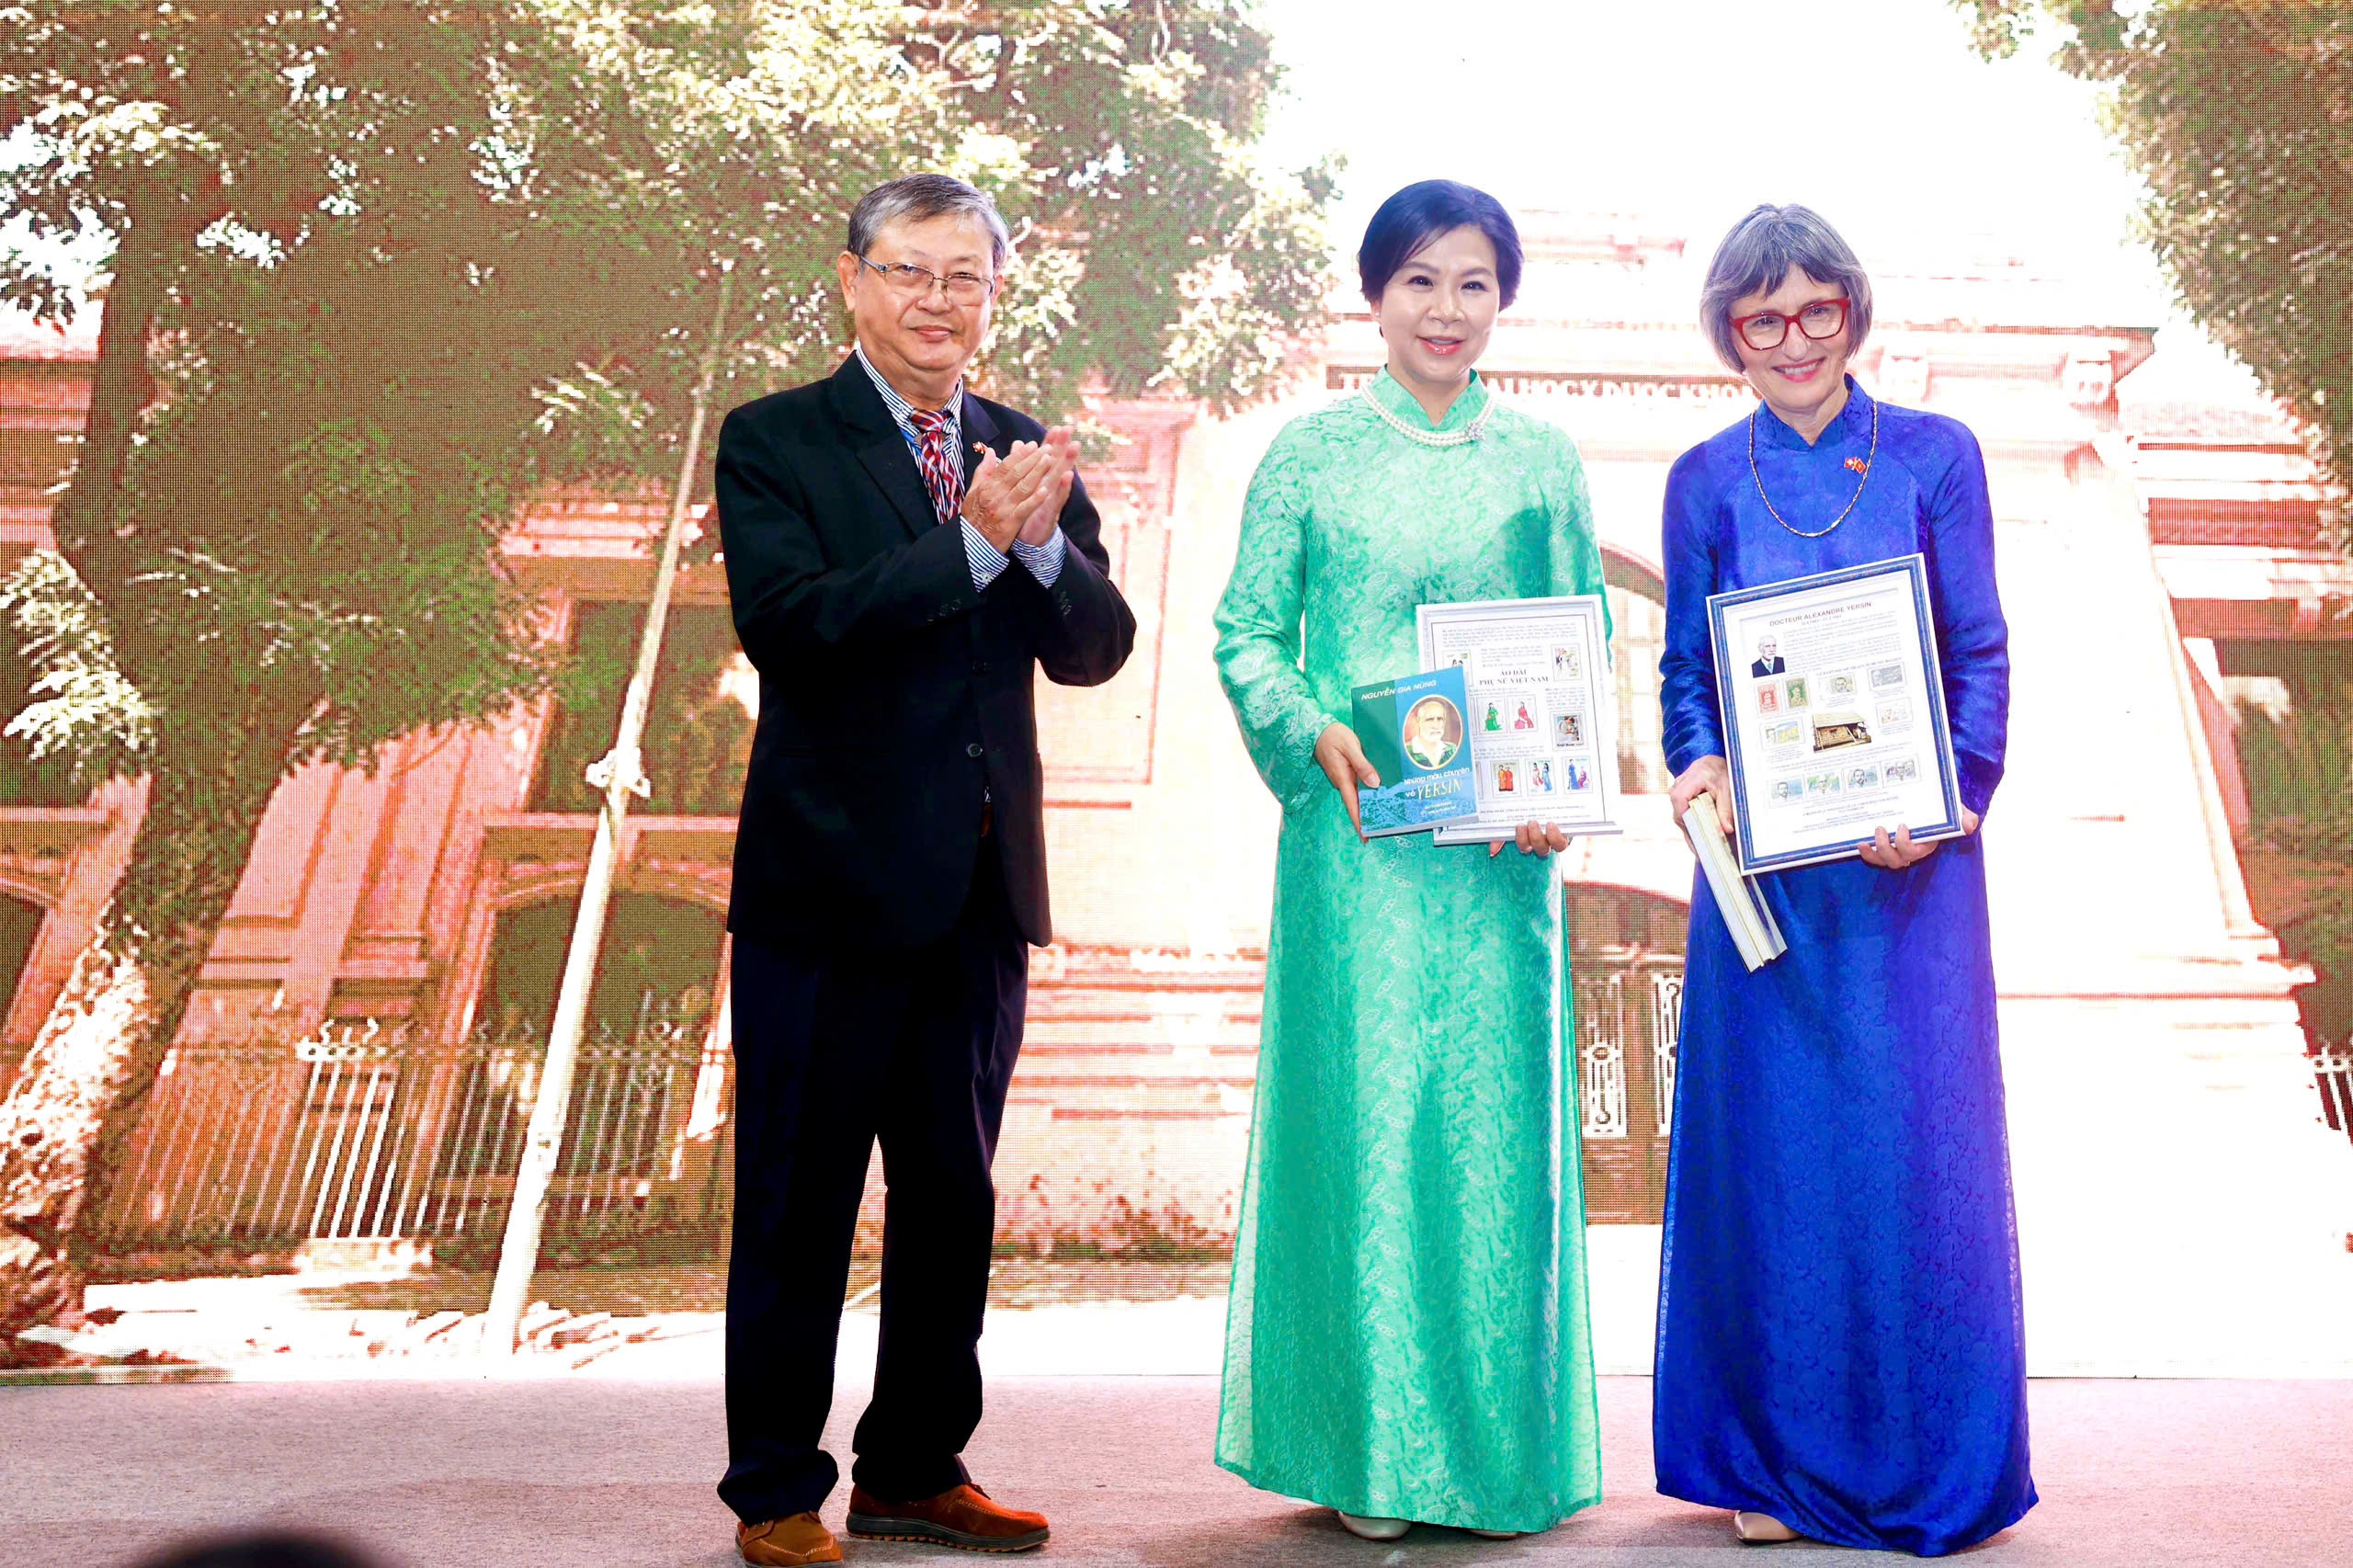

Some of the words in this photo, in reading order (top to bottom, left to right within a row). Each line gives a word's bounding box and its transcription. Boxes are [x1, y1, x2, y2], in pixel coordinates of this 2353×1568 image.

[1769, 615, 1802, 626] DOCTEUR
[1803, 608, 1846, 619] ALEXANDRE
[1847, 602, 1872, 611] YERSIN
[1397, 685, 1413, 694] GIA
[1417, 778, 1461, 801] YERSIN
